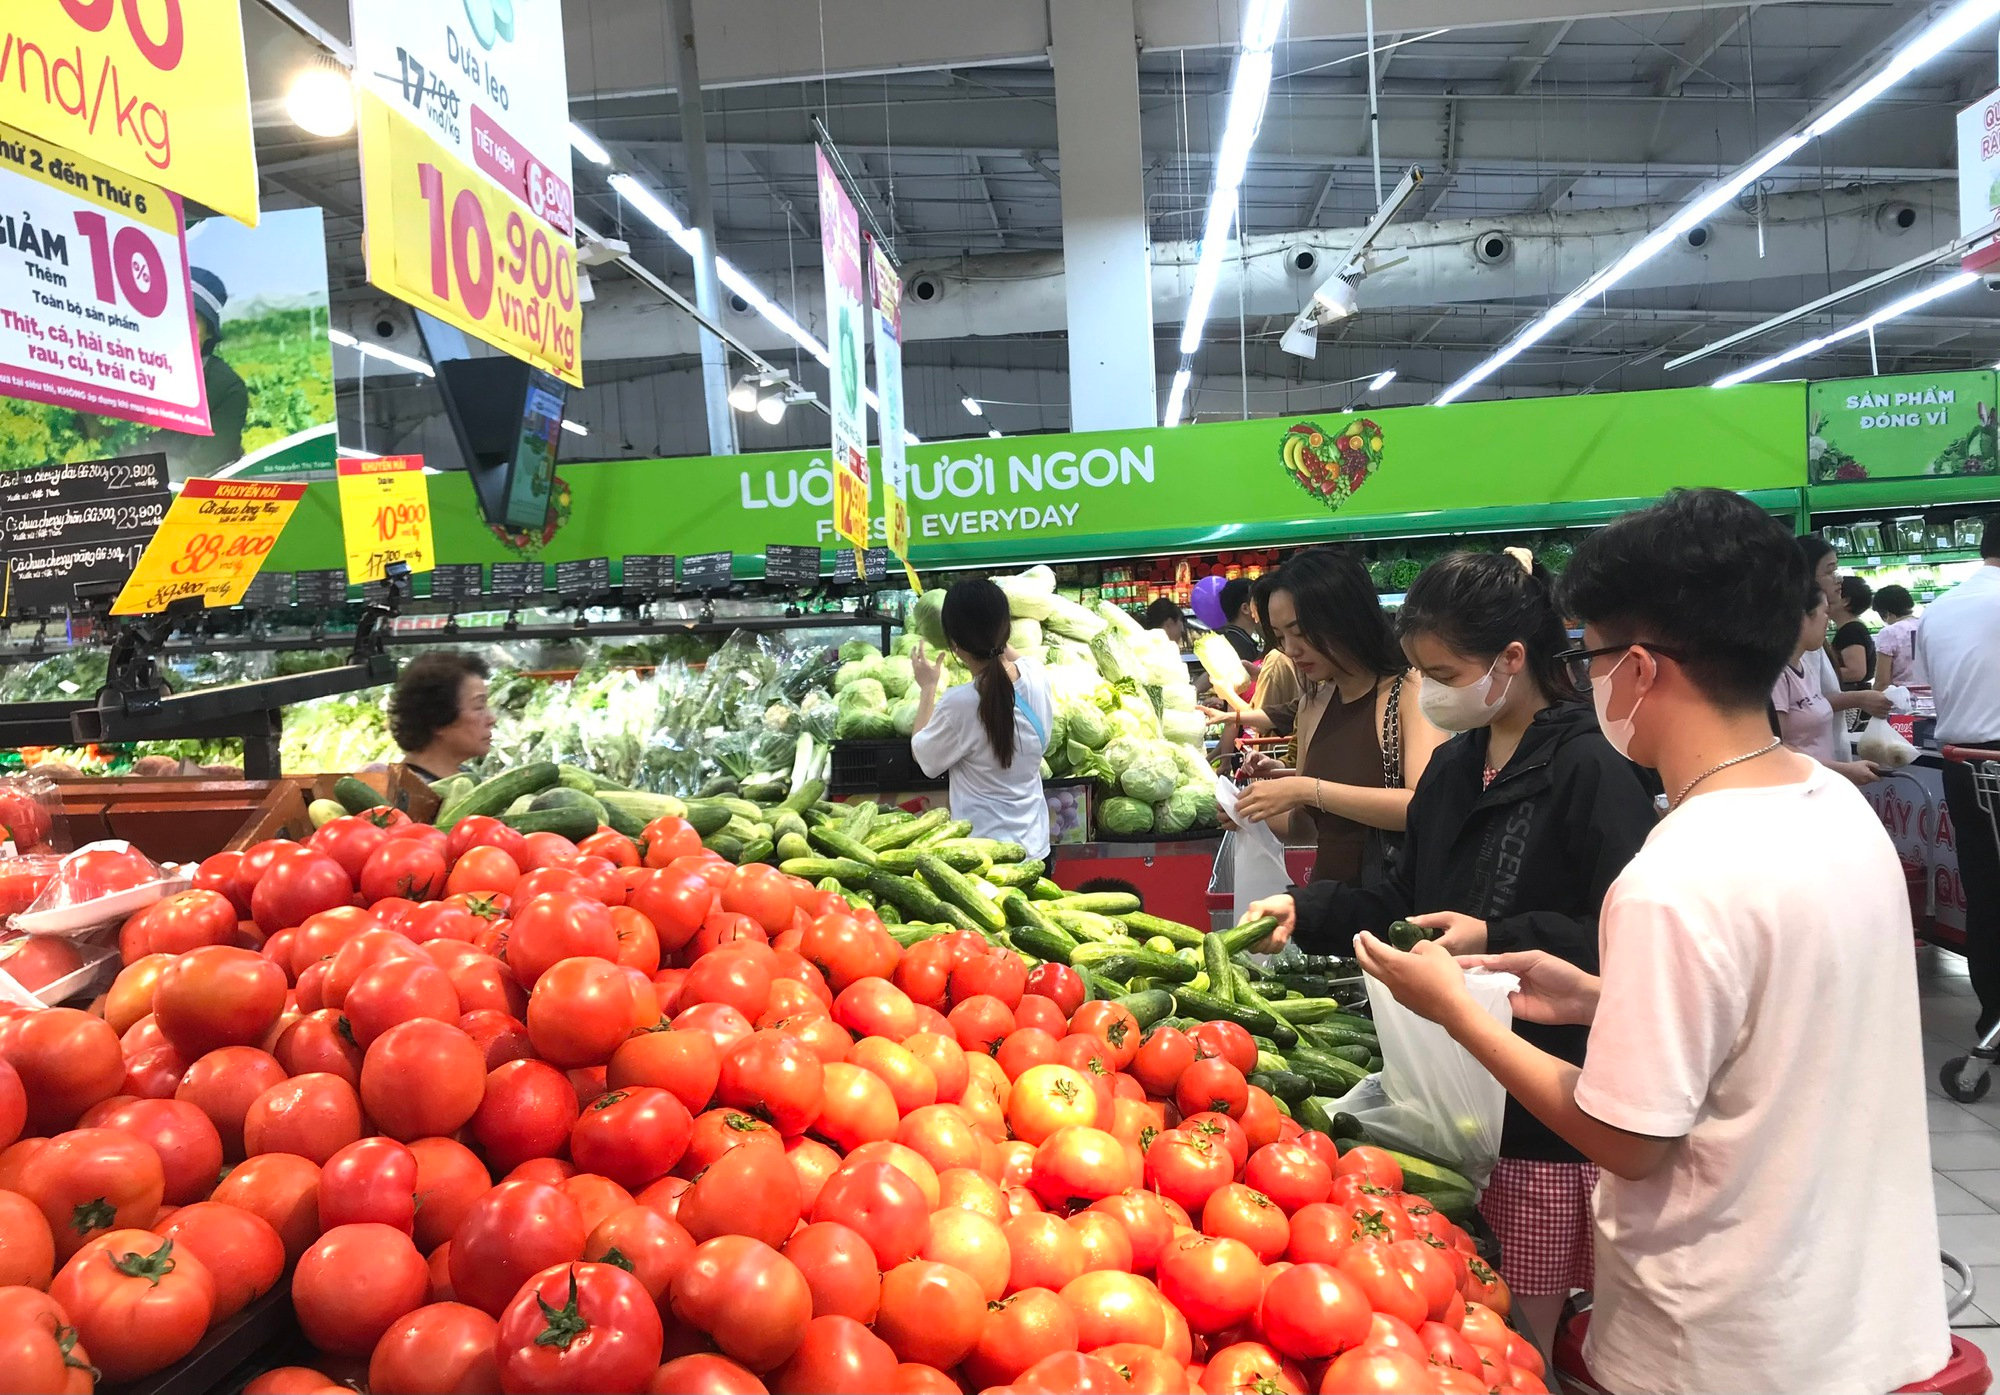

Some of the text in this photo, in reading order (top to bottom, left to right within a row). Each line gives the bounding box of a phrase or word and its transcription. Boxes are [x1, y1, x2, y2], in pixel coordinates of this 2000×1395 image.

[446, 25, 509, 111] Dưa leo
[29, 149, 45, 173] 2
[48, 158, 88, 191] đến
[92, 176, 133, 208] Thứ
[135, 194, 148, 214] 6
[25, 261, 67, 288] Thêm
[32, 289, 65, 310] Toàn
[28, 344, 64, 370] rau,
[129, 368, 156, 391] cây
[1846, 390, 1891, 409] SẢN
[740, 458, 873, 509] LUÔ
[1009, 444, 1155, 494] NGON
[922, 502, 1080, 538] EVERYDAY
